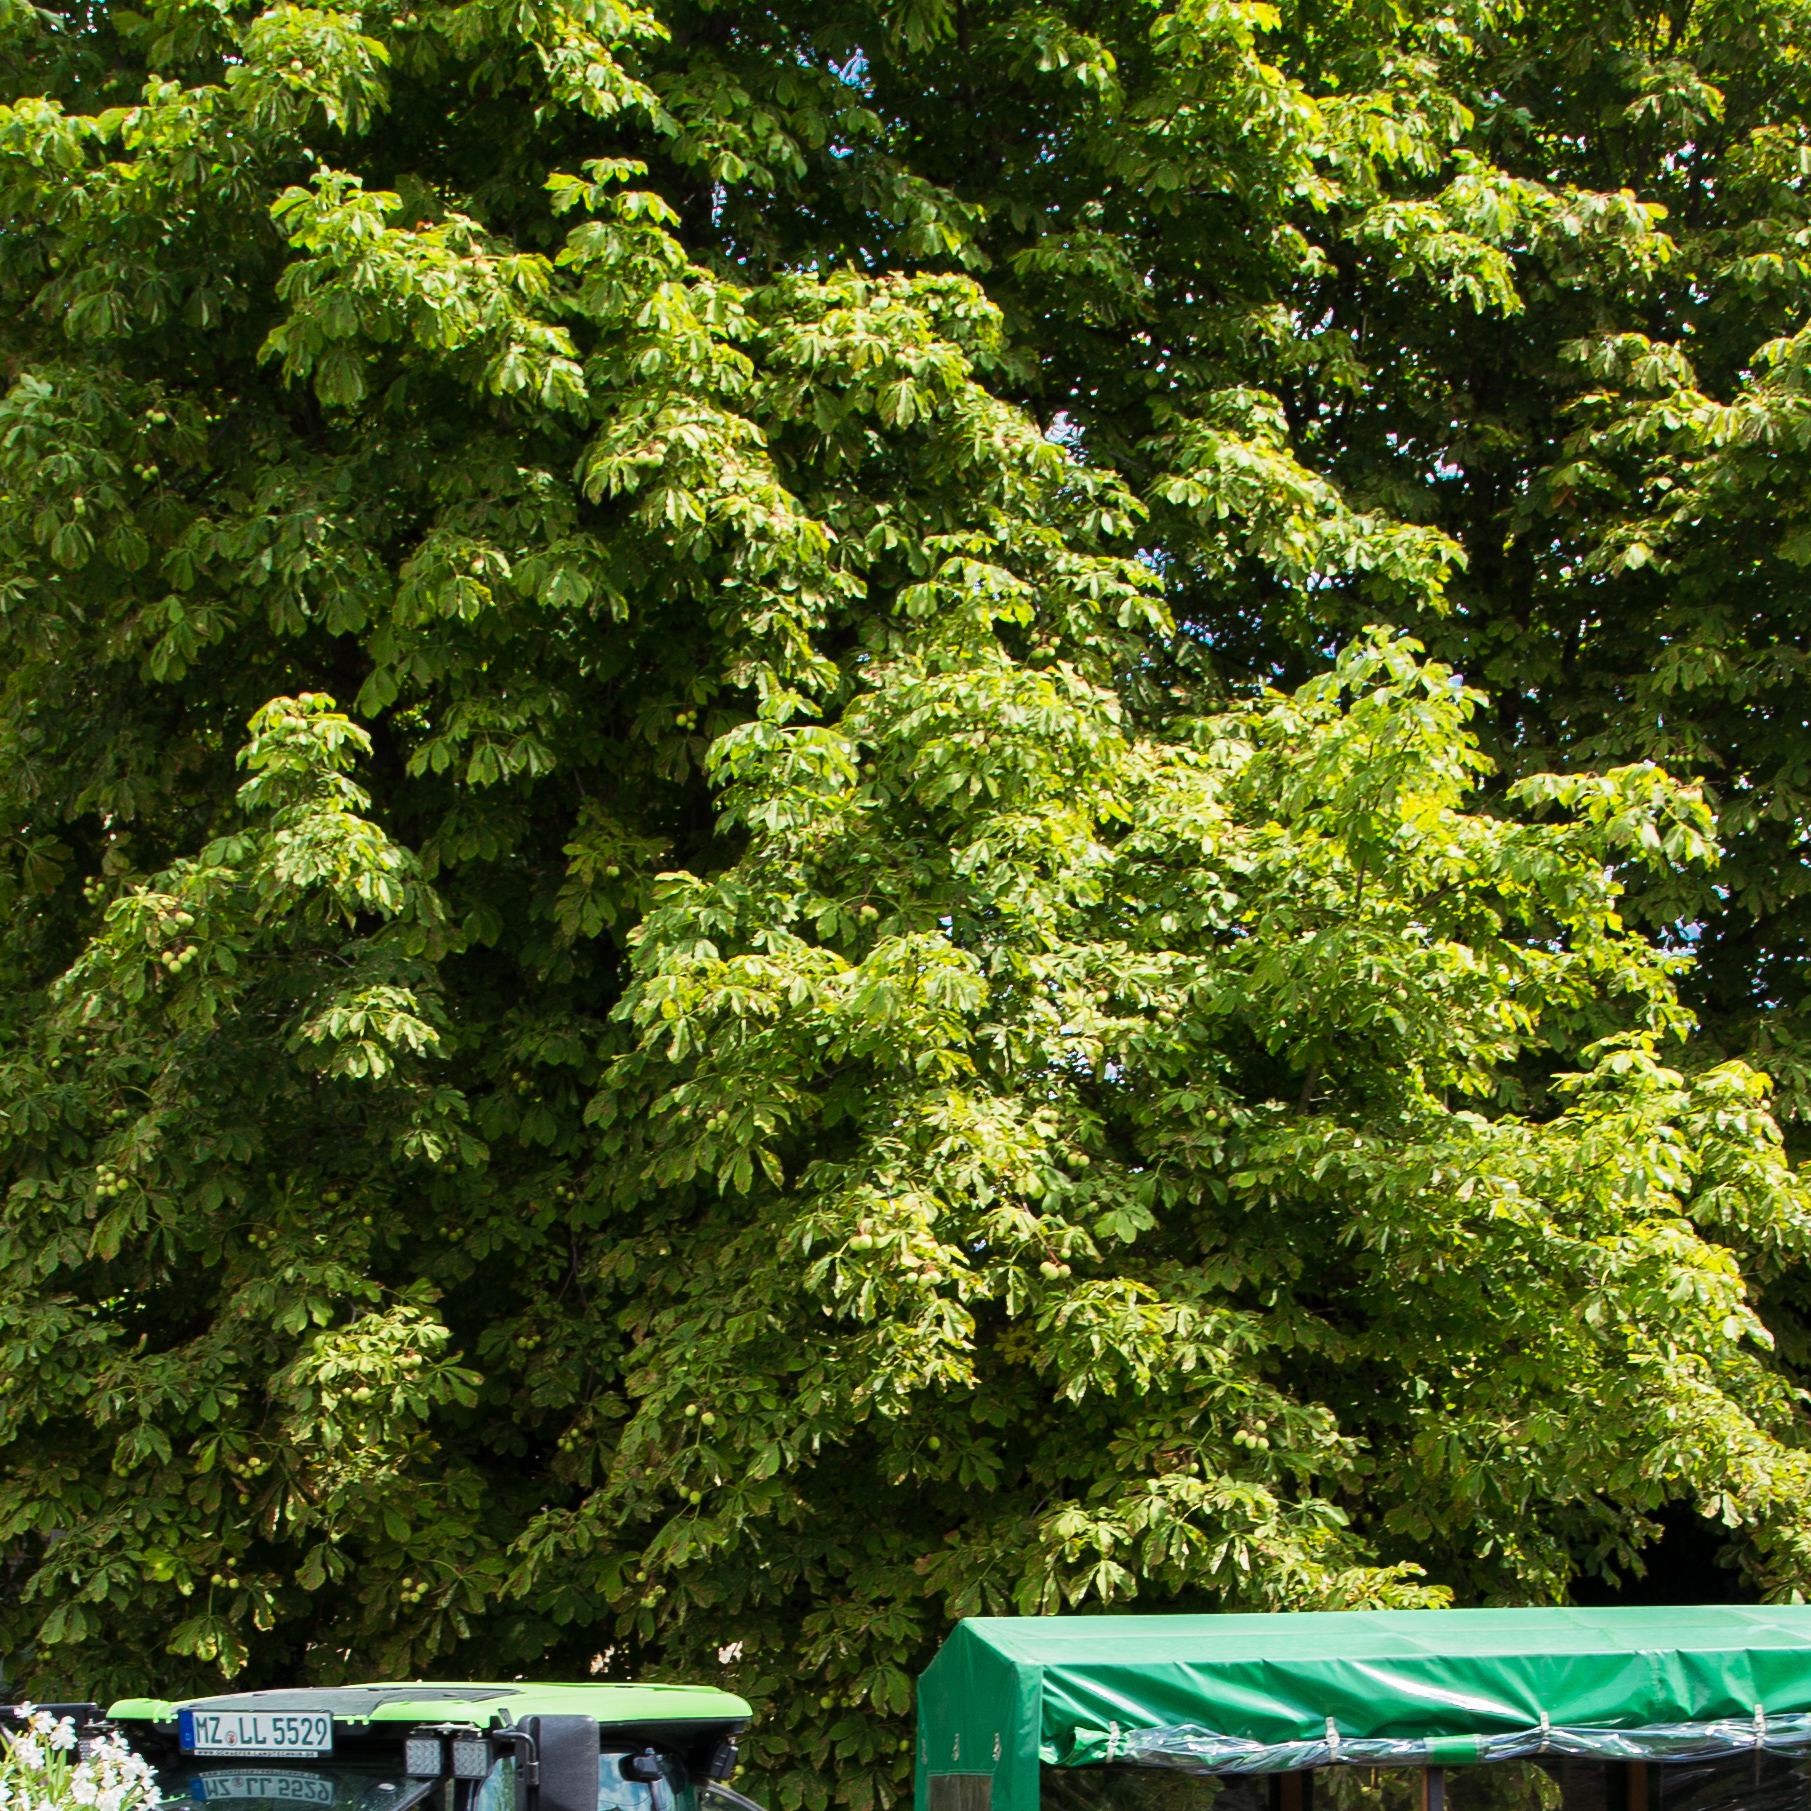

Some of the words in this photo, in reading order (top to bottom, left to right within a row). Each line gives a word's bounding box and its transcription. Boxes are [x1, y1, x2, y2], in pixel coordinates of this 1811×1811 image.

[195, 1716, 223, 1744] MZ
[238, 1717, 267, 1745] LL
[272, 1717, 327, 1746] 5529
